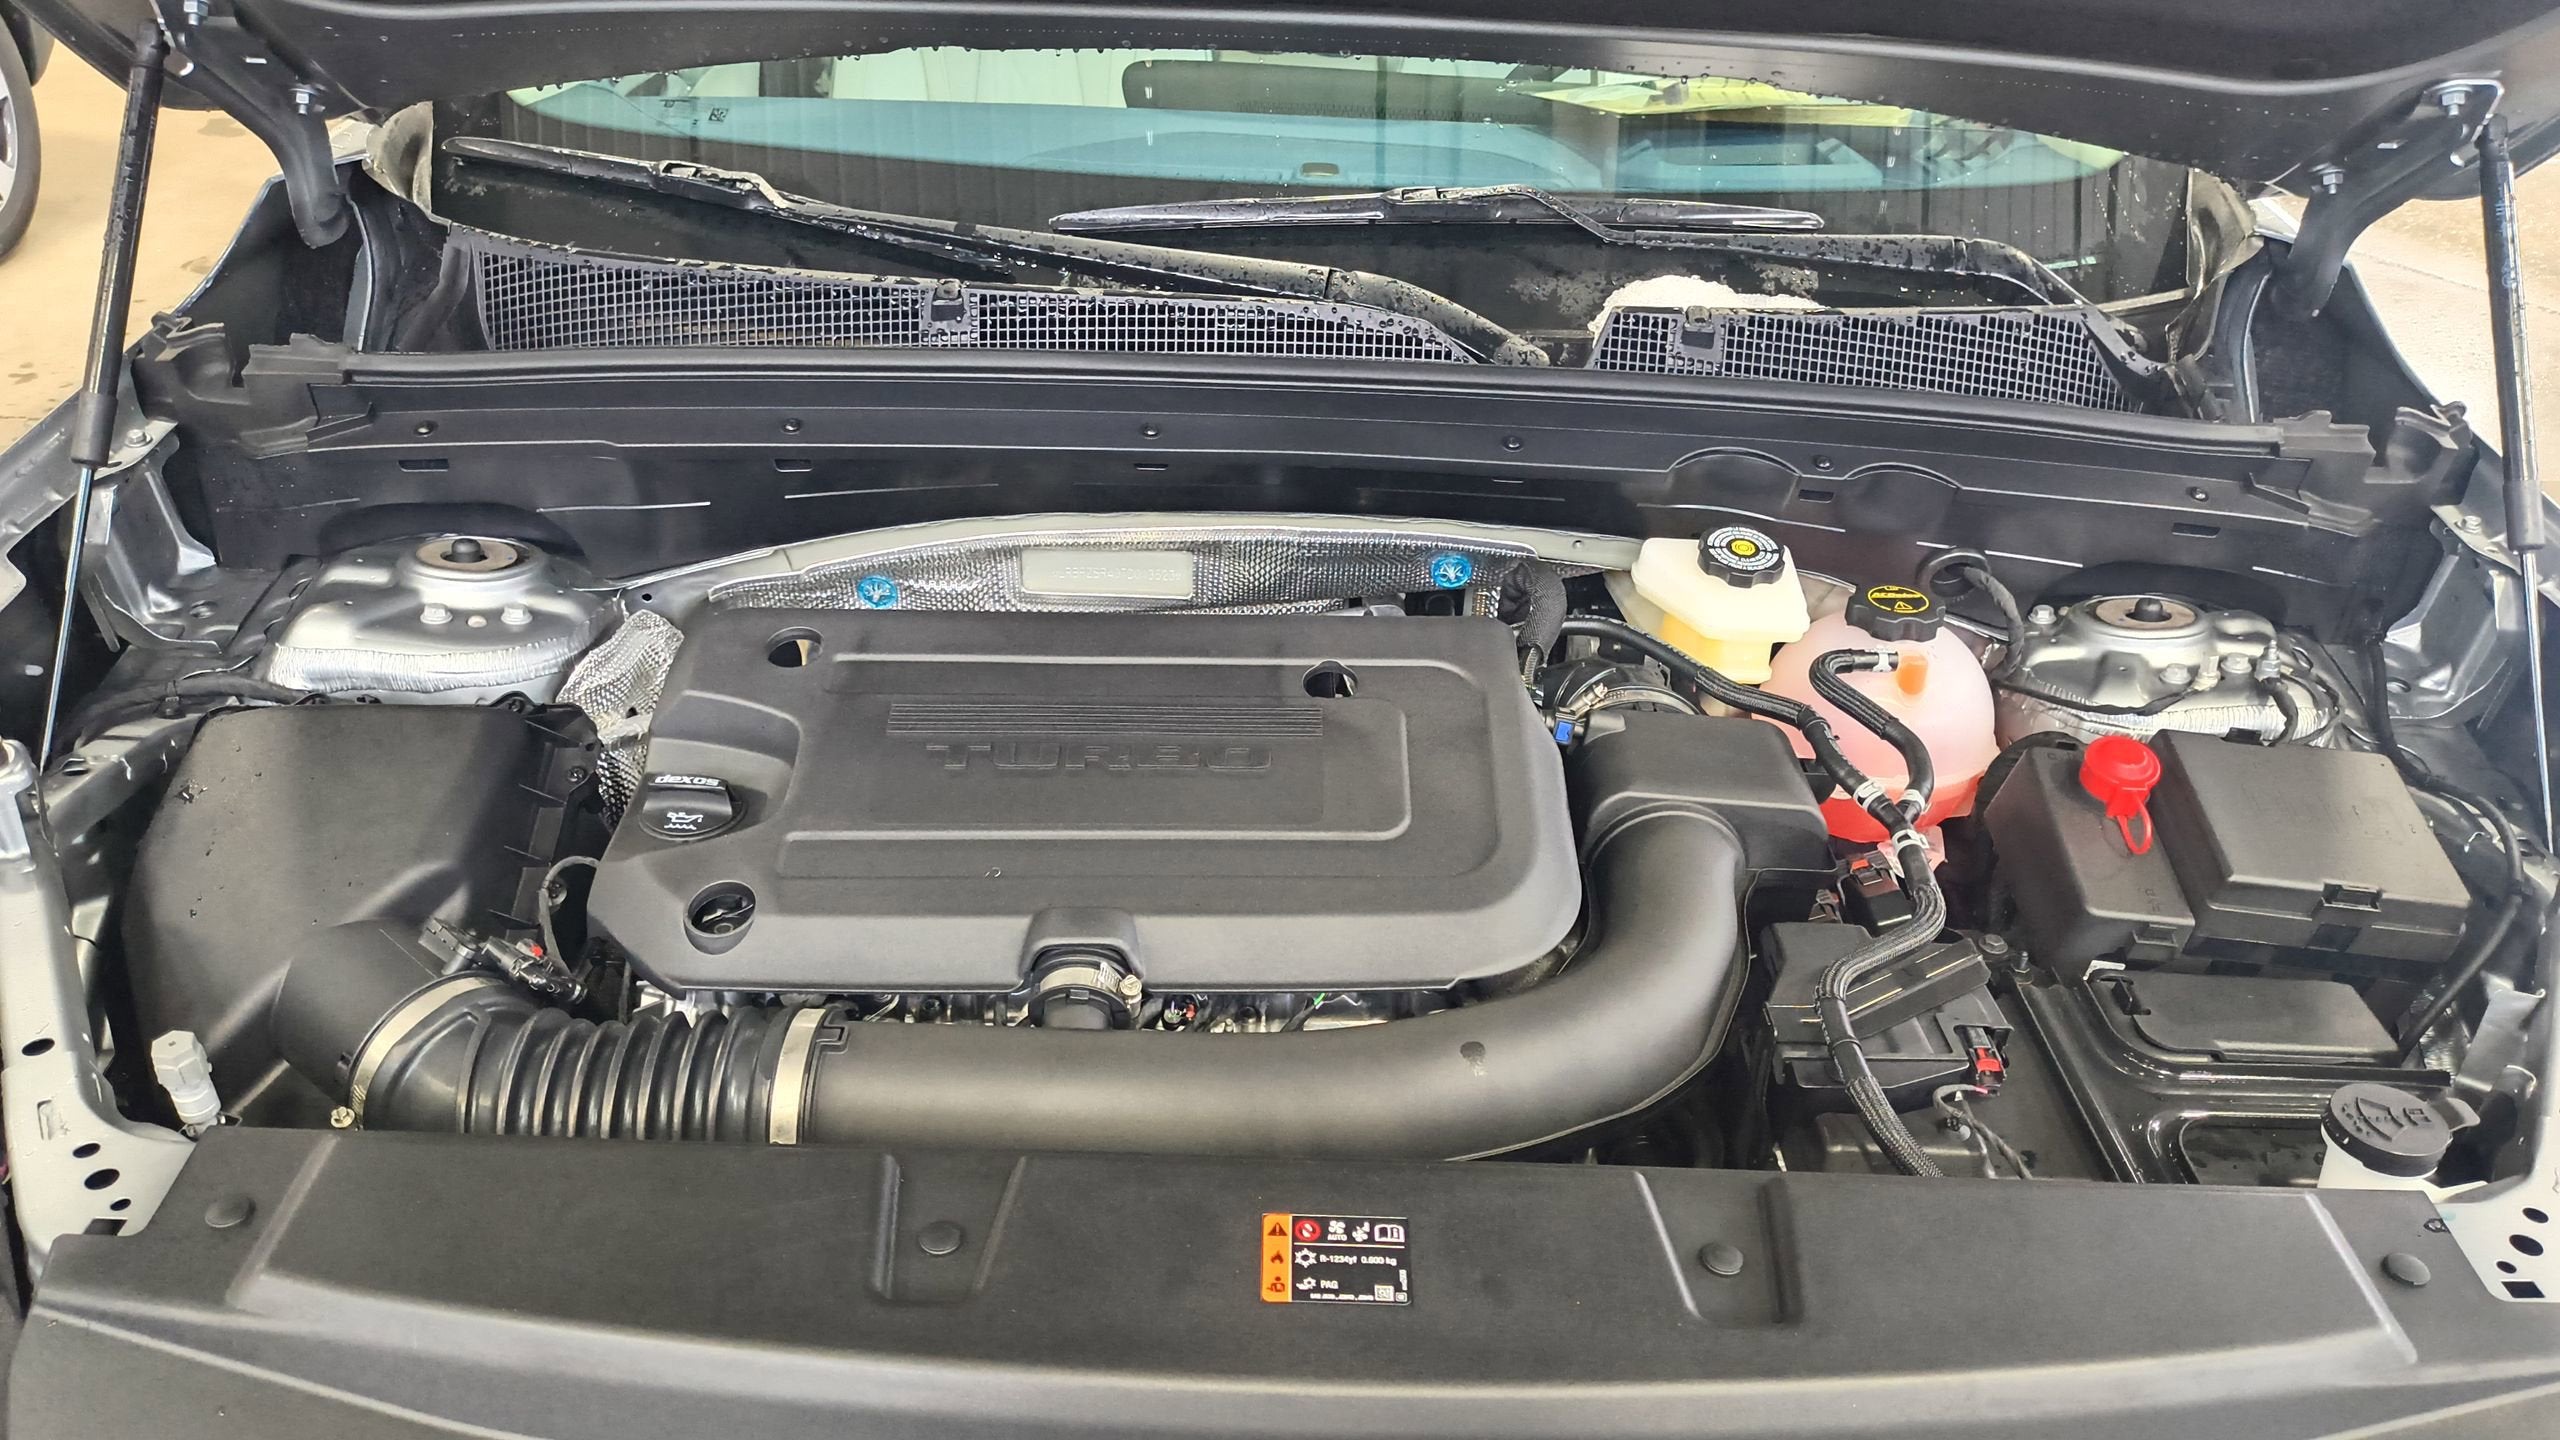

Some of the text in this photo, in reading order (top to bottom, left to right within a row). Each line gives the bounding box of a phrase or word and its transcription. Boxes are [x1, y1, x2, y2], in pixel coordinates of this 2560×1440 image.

[925, 742, 1272, 771] TURBO
[654, 774, 721, 787] dexos
[1327, 1233, 1348, 1242] AUTO
[1319, 1254, 1358, 1265] R-1234yf
[1385, 1256, 1398, 1266] kg
[1320, 1279, 1339, 1290] PAG
